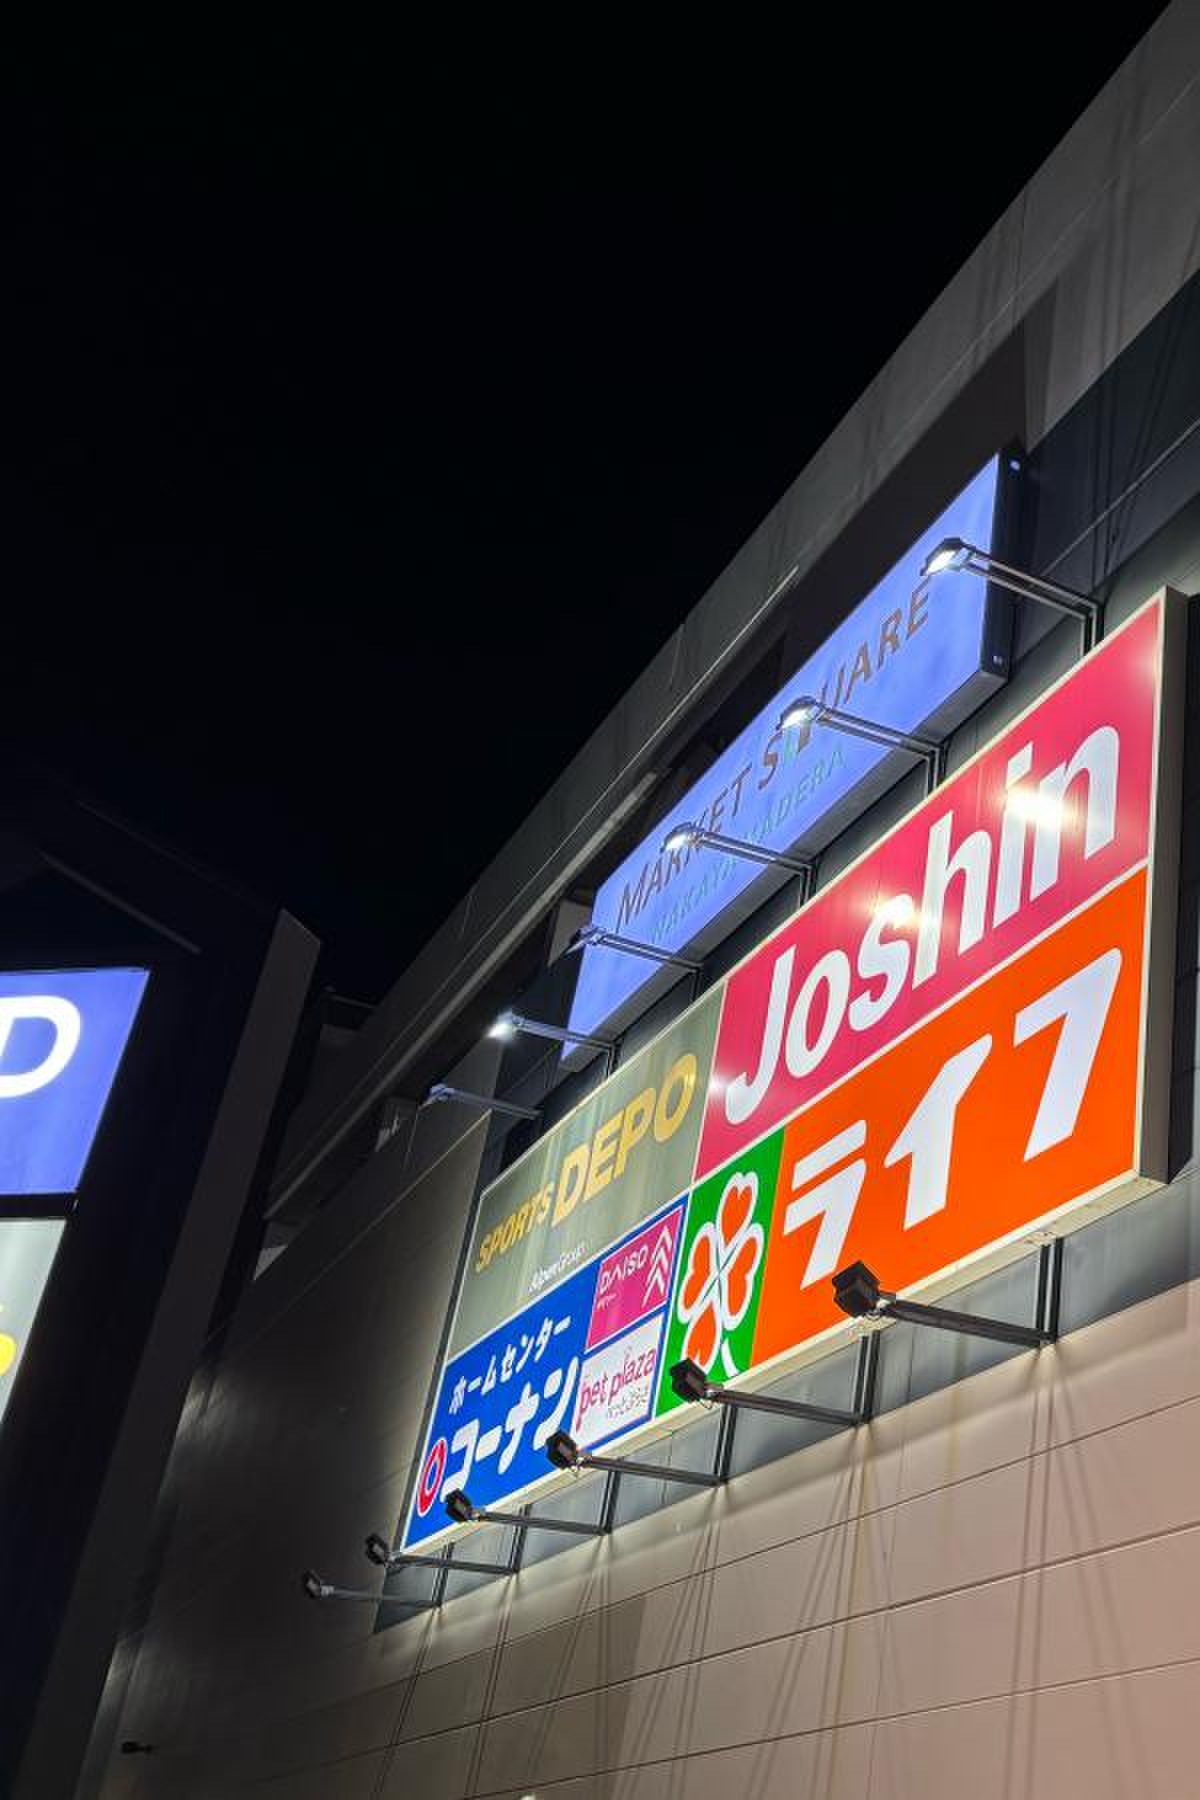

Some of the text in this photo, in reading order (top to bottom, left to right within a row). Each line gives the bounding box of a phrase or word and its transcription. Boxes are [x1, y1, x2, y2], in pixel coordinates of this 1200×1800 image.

[724, 725, 1119, 1126] Joshin
[476, 1054, 698, 1274] SPORTS DEPO
[783, 947, 1121, 1291] ライフ
[440, 1356, 579, 1502] コーナン
[449, 1315, 572, 1414] ホームセンター
[576, 1373, 609, 1433] pet
